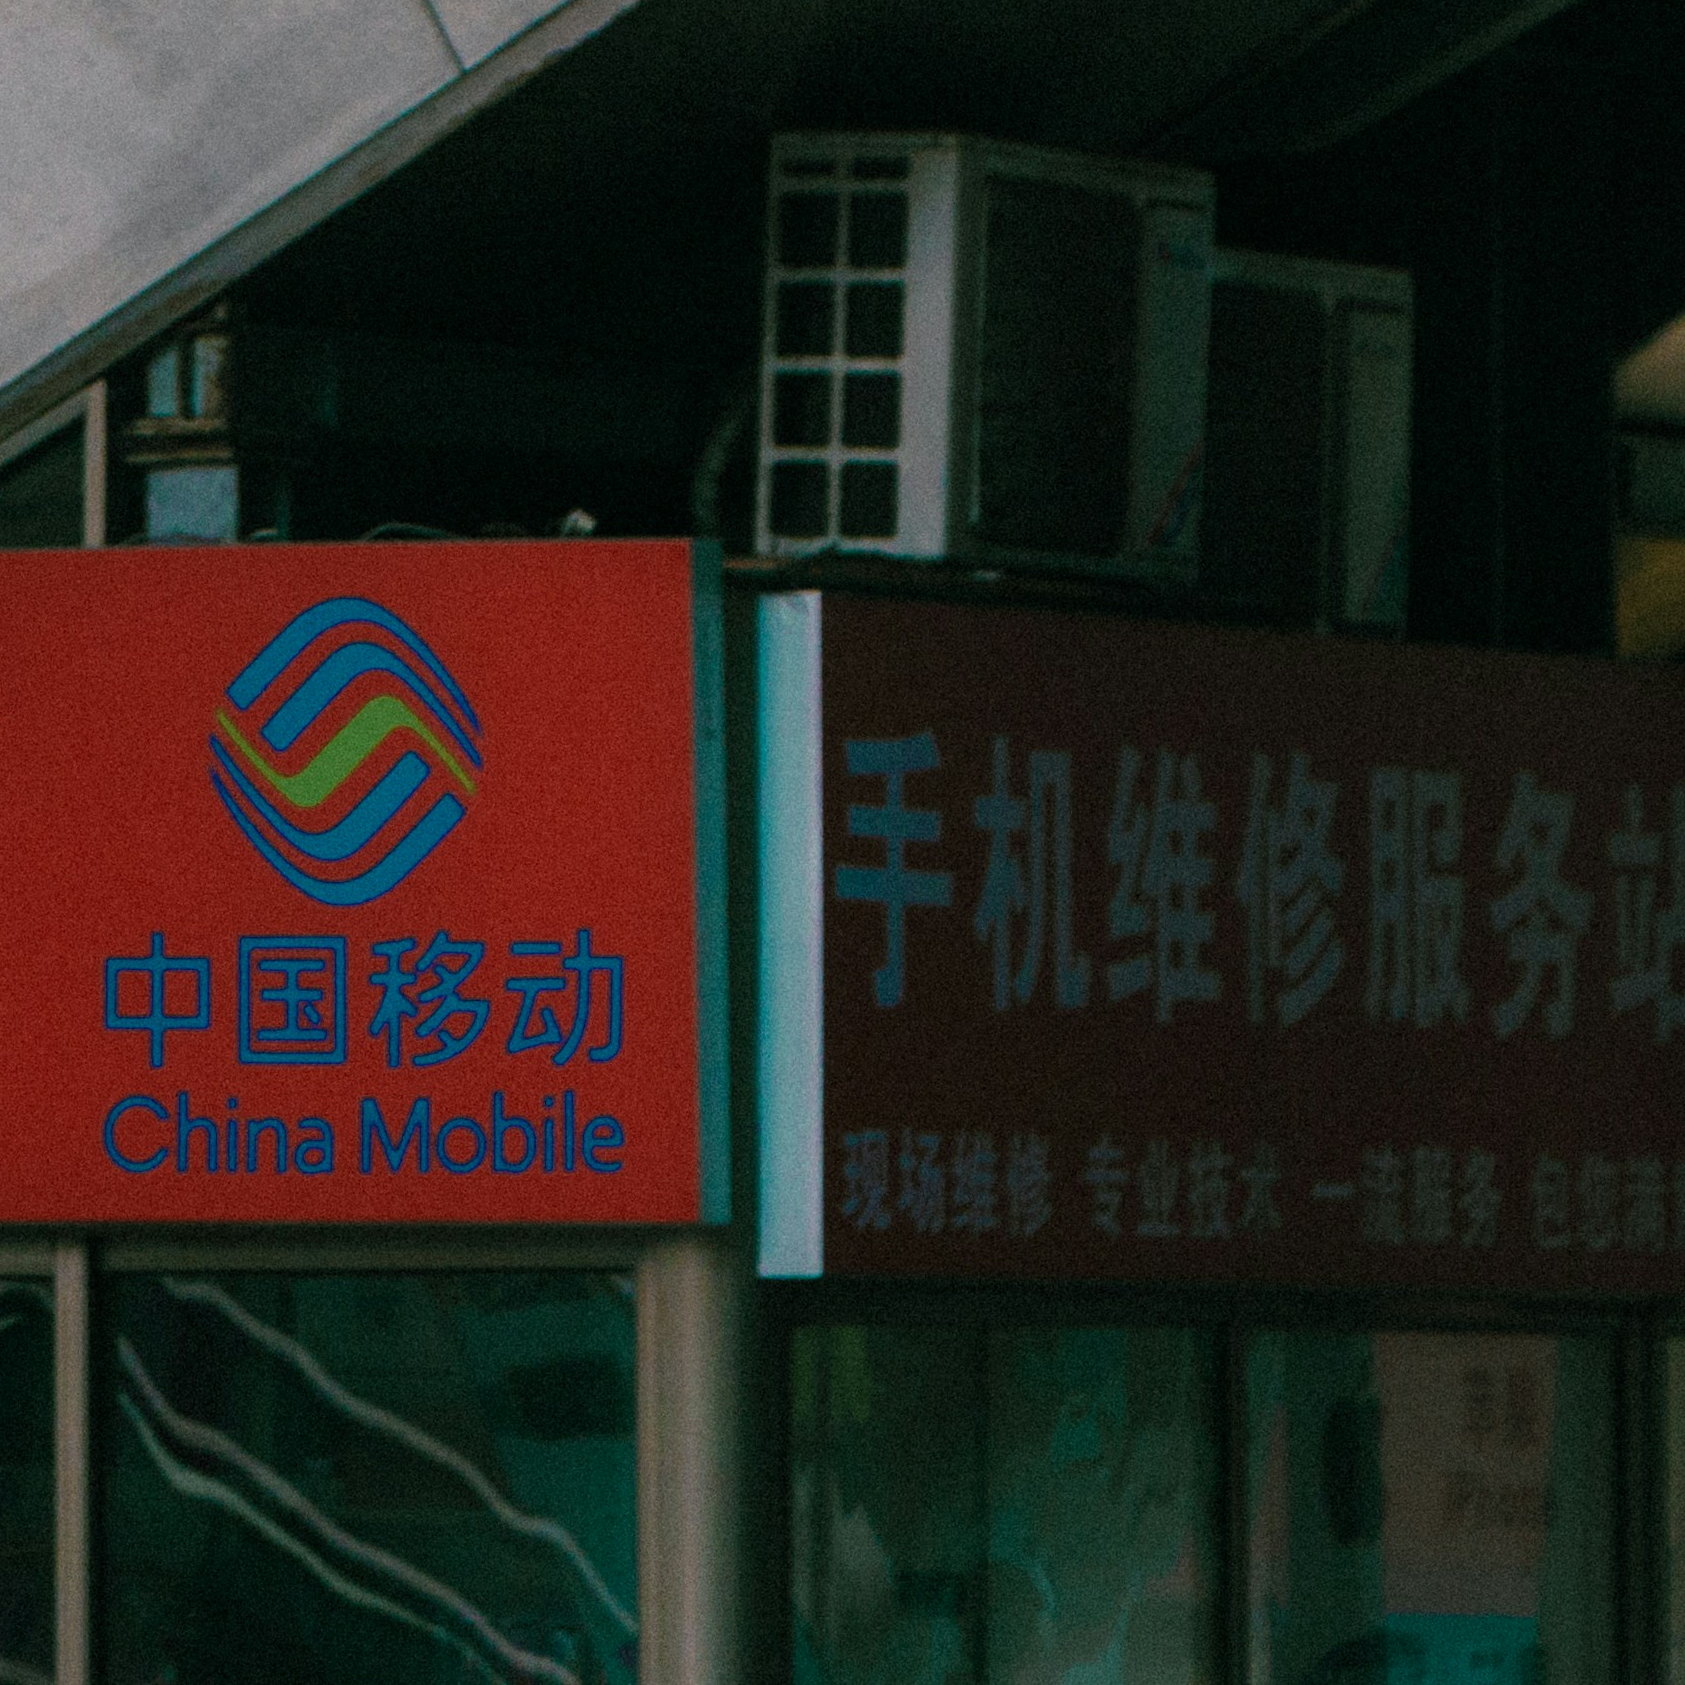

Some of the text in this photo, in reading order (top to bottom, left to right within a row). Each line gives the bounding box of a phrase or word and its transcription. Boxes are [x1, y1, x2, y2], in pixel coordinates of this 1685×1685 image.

[104, 928, 624, 1069] 中国移动
[103, 1089, 625, 1175] China Mobile
